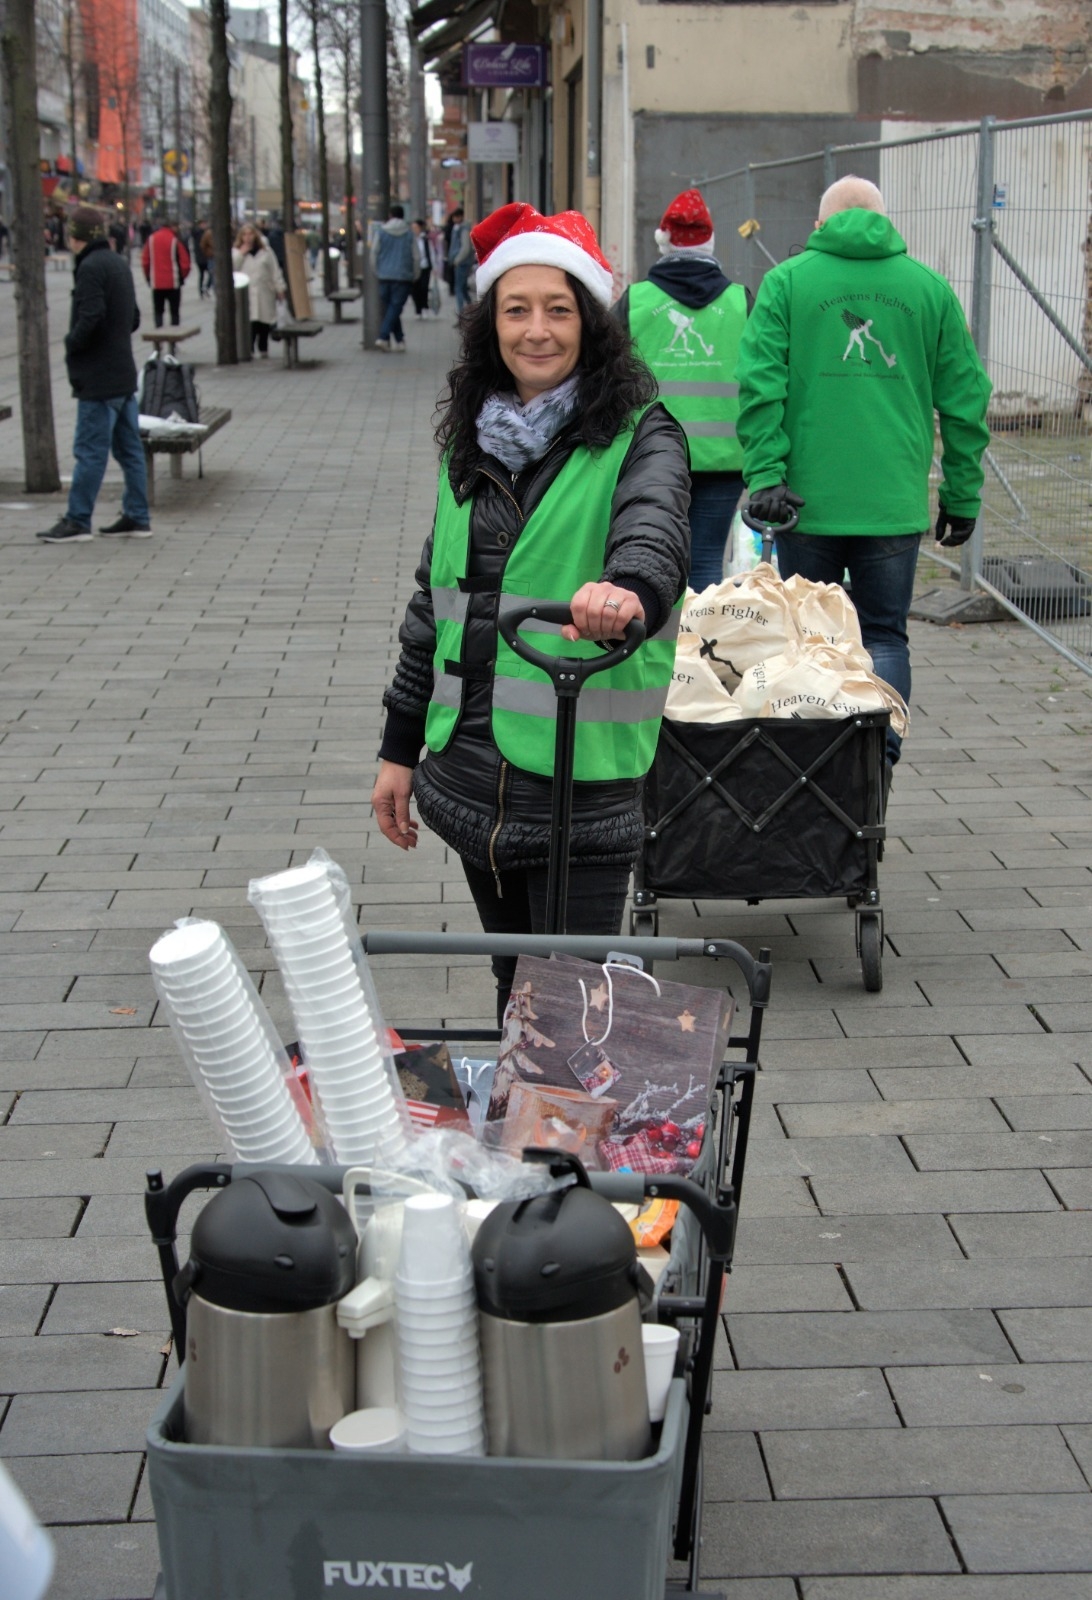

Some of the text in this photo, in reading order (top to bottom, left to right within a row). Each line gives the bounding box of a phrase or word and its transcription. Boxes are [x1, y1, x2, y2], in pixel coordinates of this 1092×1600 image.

[818, 292, 917, 318] Heavens Fighter
[721, 604, 769, 627] Fighter
[771, 694, 827, 714] Heaven
[323, 1560, 446, 1591] FUXTEC
